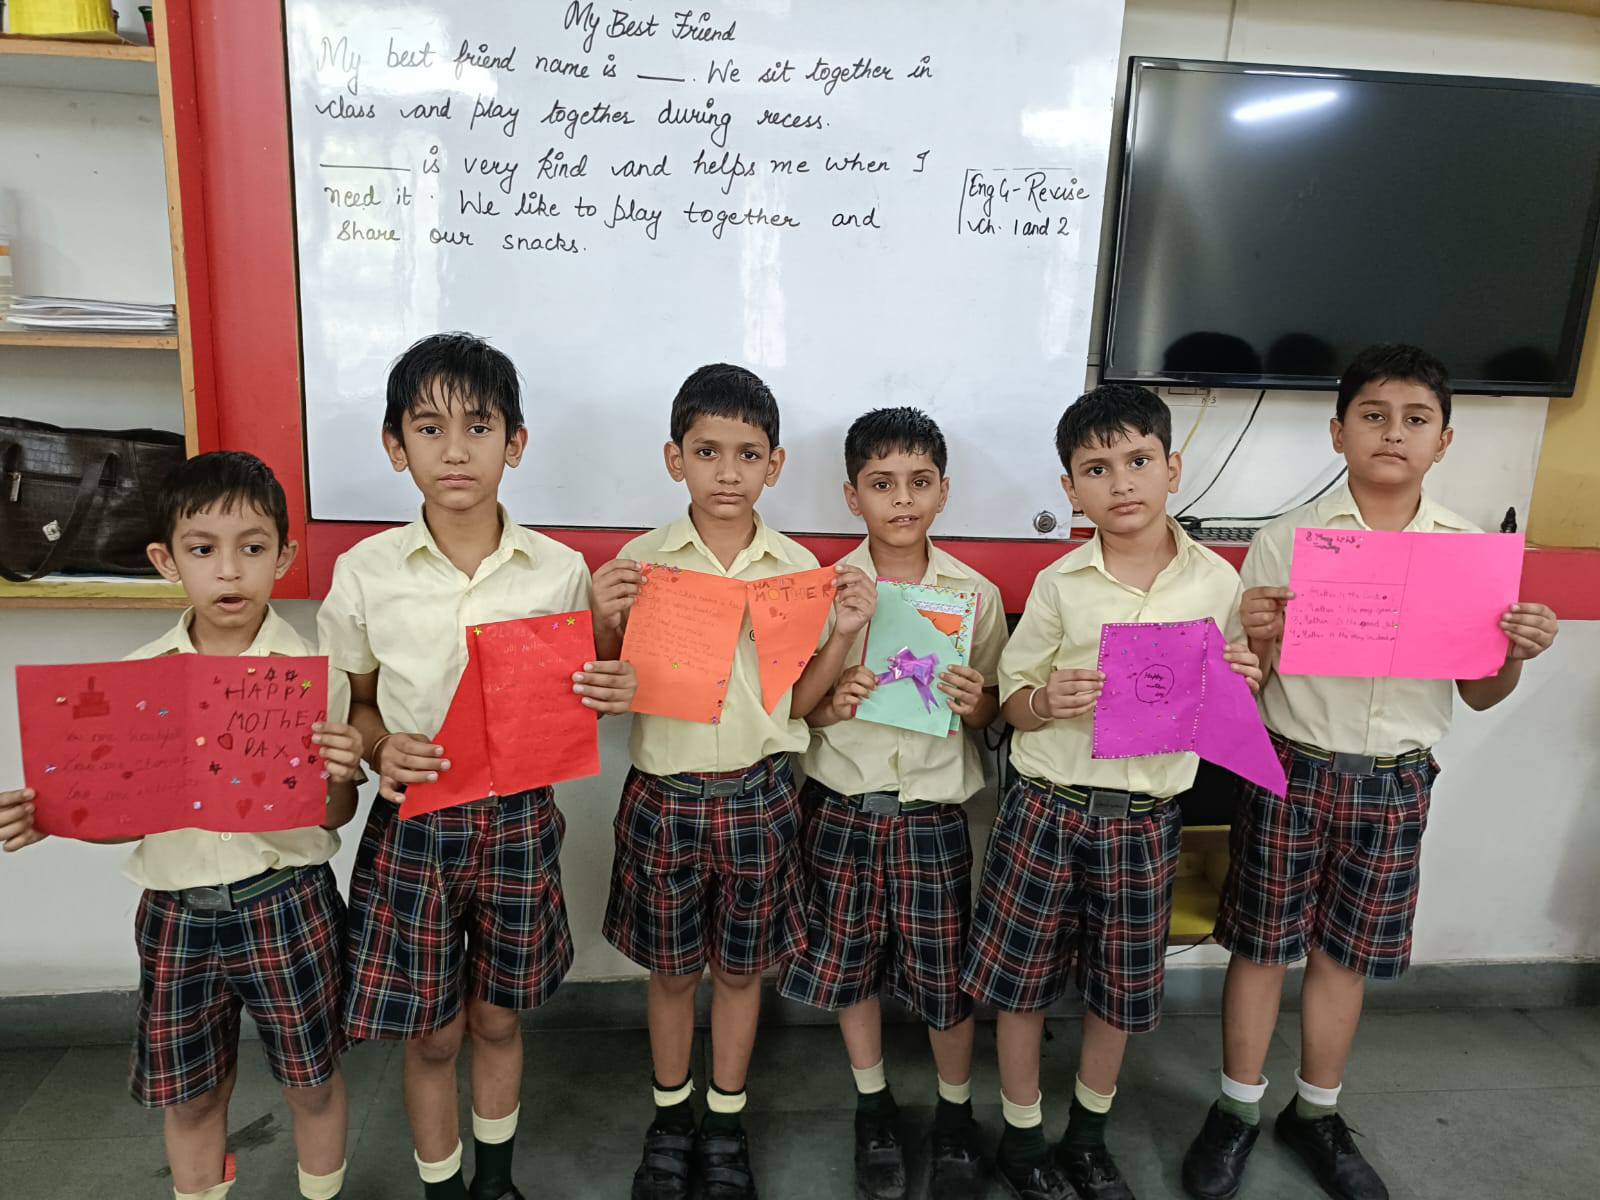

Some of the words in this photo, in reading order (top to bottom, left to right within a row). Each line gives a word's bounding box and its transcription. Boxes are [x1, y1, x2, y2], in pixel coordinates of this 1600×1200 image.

[564, 0, 601, 53] My
[606, 10, 659, 37] Best
[672, 12, 736, 42] Friend
[316, 36, 361, 95] My
[386, 38, 436, 68] best
[453, 40, 516, 80] friend
[535, 55, 590, 79] name
[602, 54, 617, 78] is
[707, 60, 741, 83] We
[757, 61, 796, 83] sit
[805, 59, 894, 95] together
[907, 56, 933, 79] in
[315, 95, 375, 119] class
[399, 96, 452, 120] and
[470, 93, 520, 137] play
[540, 100, 635, 139] together
[657, 97, 732, 147] during
[757, 114, 830, 130] recess.
[422, 145, 440, 174] is
[463, 158, 518, 194] very
[537, 148, 589, 179] kind
[611, 157, 672, 177] and
[693, 149, 756, 195] helps
[770, 160, 810, 174] me
[826, 155, 890, 173] when
[968, 172, 994, 217] Eng
[324, 187, 382, 207] need
[397, 188, 412, 206] it
[459, 190, 501, 216] We
[514, 191, 560, 217] like
[574, 196, 597, 217] to
[603, 195, 662, 240] play
[683, 202, 800, 239] together
[832, 214, 880, 229] and
[1013, 218, 1019, 236] 1
[1022, 216, 1050, 236] and
[1056, 216, 1069, 236] 2
[430, 228, 474, 246] our
[502, 234, 586, 253] snacks.
